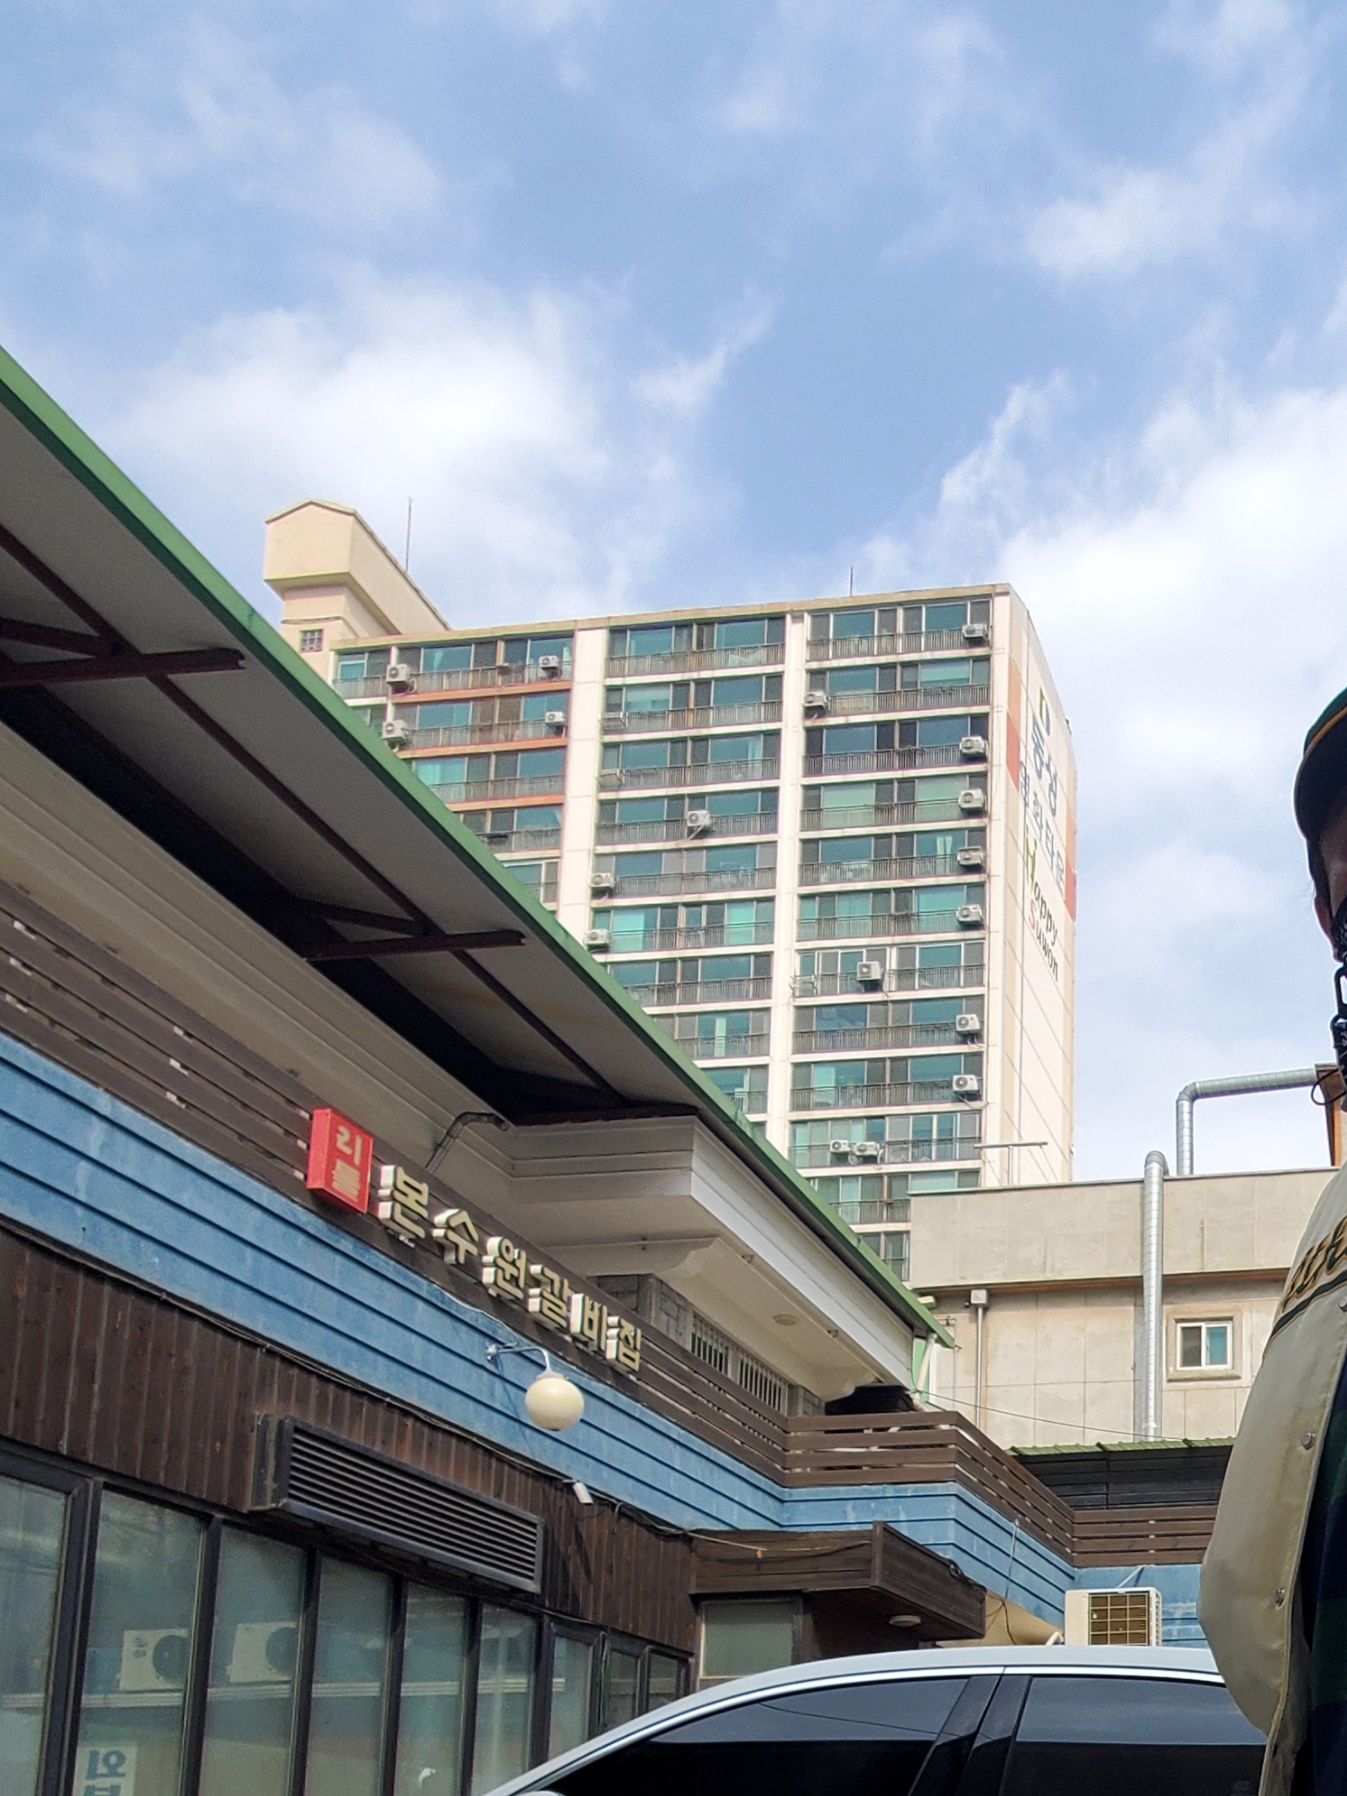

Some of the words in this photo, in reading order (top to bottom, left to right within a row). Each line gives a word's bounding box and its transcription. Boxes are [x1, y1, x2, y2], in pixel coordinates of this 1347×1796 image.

[1032, 712, 1057, 817] 동성
[1025, 824, 1058, 947] Happy
[1028, 902, 1058, 982] Suwon
[380, 1165, 642, 1373] 본수원갈비집
